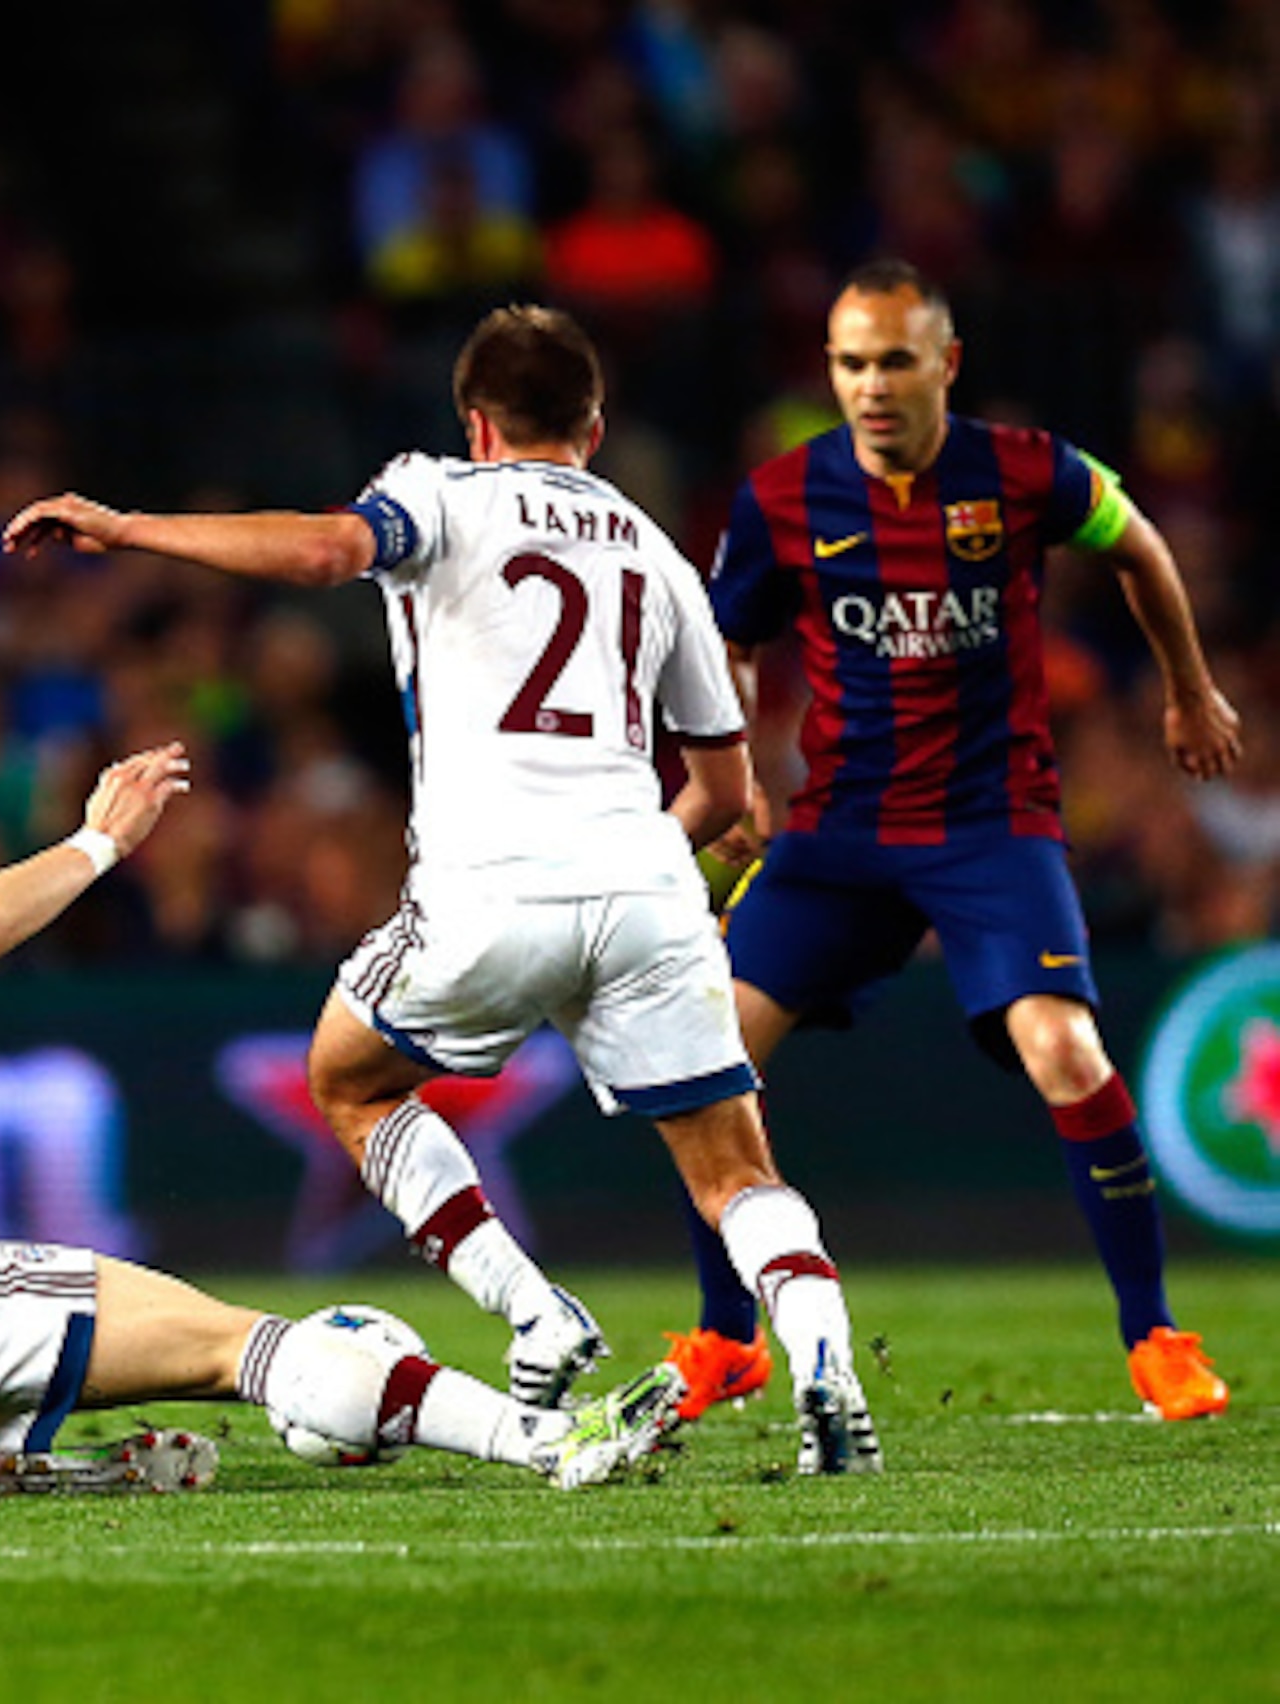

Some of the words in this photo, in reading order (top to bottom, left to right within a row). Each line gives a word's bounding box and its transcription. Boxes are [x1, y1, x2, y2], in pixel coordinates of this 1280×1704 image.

[516, 493, 638, 550] LAHM
[831, 586, 1000, 645] QATAR
[875, 625, 1000, 660] AIRWAYS
[497, 551, 647, 752] 21
